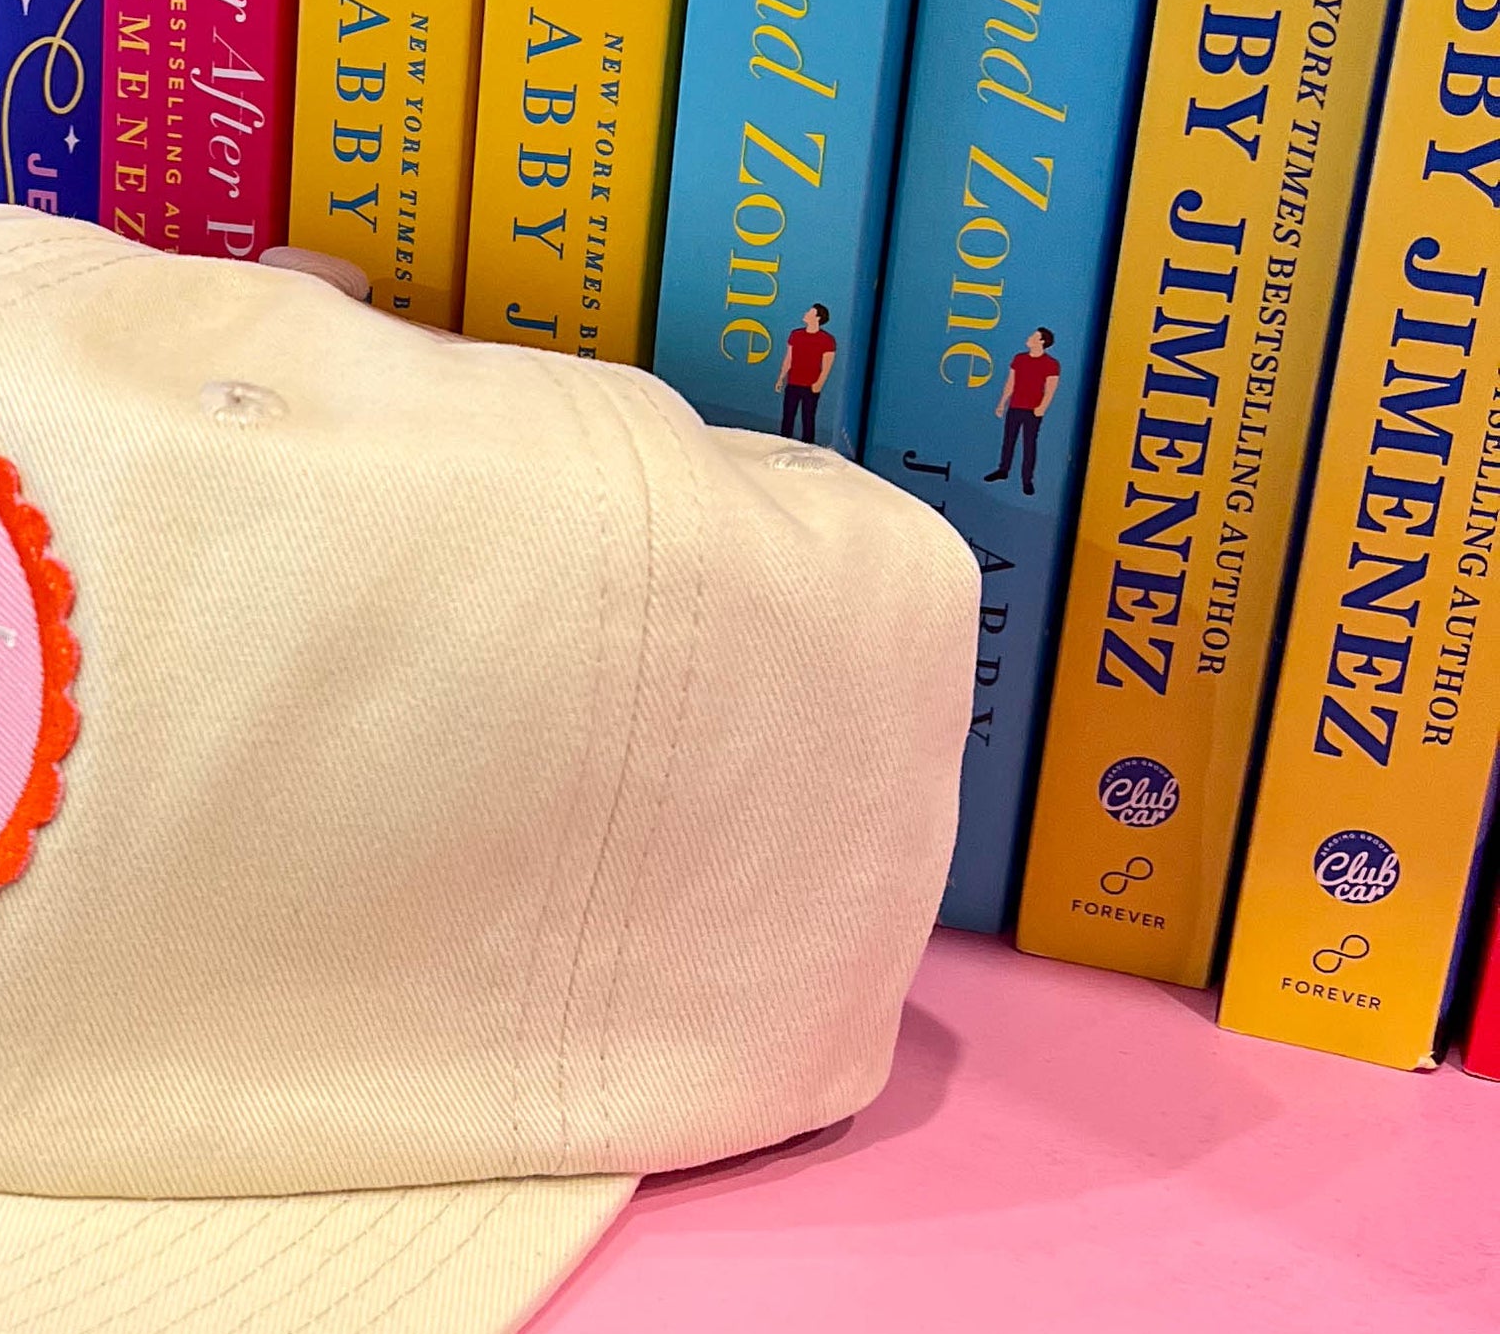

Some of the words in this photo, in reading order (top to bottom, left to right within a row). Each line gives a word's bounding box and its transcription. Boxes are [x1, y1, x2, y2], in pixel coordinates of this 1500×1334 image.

[406, 11, 429, 85] NEW
[599, 32, 626, 107] NEW
[190, 25, 267, 199] After
[400, 97, 425, 178] YORK
[512, 5, 584, 262] ABBY
[589, 118, 617, 204] YORK
[1271, 120, 1323, 249] TIMES
[394, 190, 418, 283] TIMES
[582, 215, 611, 312] TIMES
[720, 120, 827, 366] Zone
[939, 144, 1055, 390] Zone
[1224, 256, 1298, 516] BESTSELLING
[1095, 187, 1248, 697] JIMENEZ
[1313, 234, 1488, 768] JIMENEZ
[1197, 522, 1250, 677] AUTHOR
[1422, 584, 1482, 747] AUTHOR
[1102, 777, 1178, 810] Club
[1119, 809, 1166, 825] car
[1071, 898, 1167, 931] FOREVER
[1316, 851, 1399, 886] Club
[1334, 884, 1385, 902] car
[1281, 976, 1382, 1012] FOREVER
